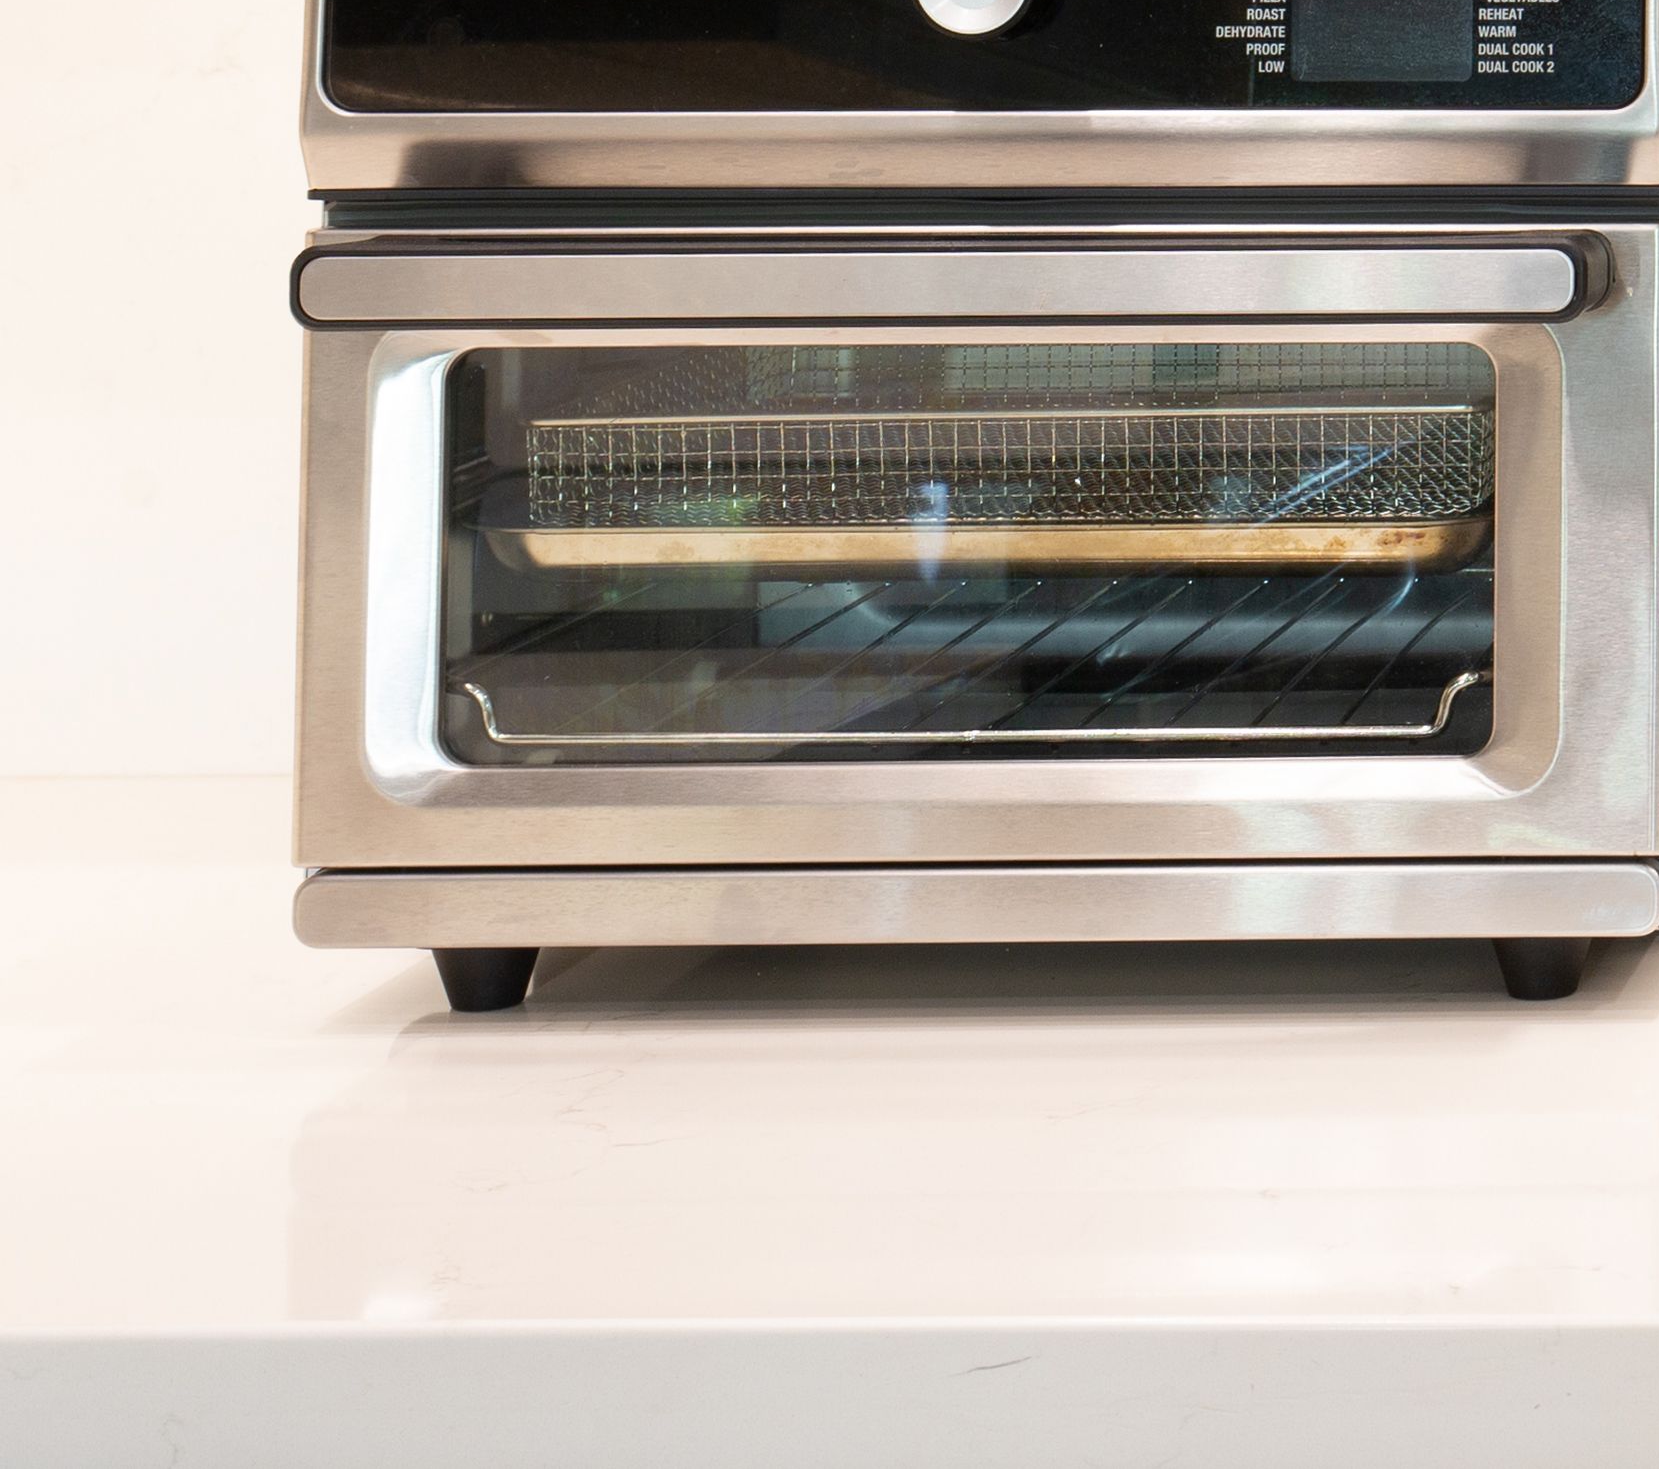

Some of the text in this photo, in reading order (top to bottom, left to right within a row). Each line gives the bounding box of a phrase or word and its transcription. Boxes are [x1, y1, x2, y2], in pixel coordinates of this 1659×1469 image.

[1246, 8, 1286, 21] ROAST
[1478, 8, 1524, 20] REHEAT
[1215, 25, 1285, 38] DEHYDRATE
[1478, 25, 1516, 38] WARM
[1246, 43, 1286, 56] PROOF
[1478, 43, 1553, 56] DUAL COOK 1
[1258, 60, 1285, 73] LOW
[1478, 60, 1555, 73] DUAL COOK 2
